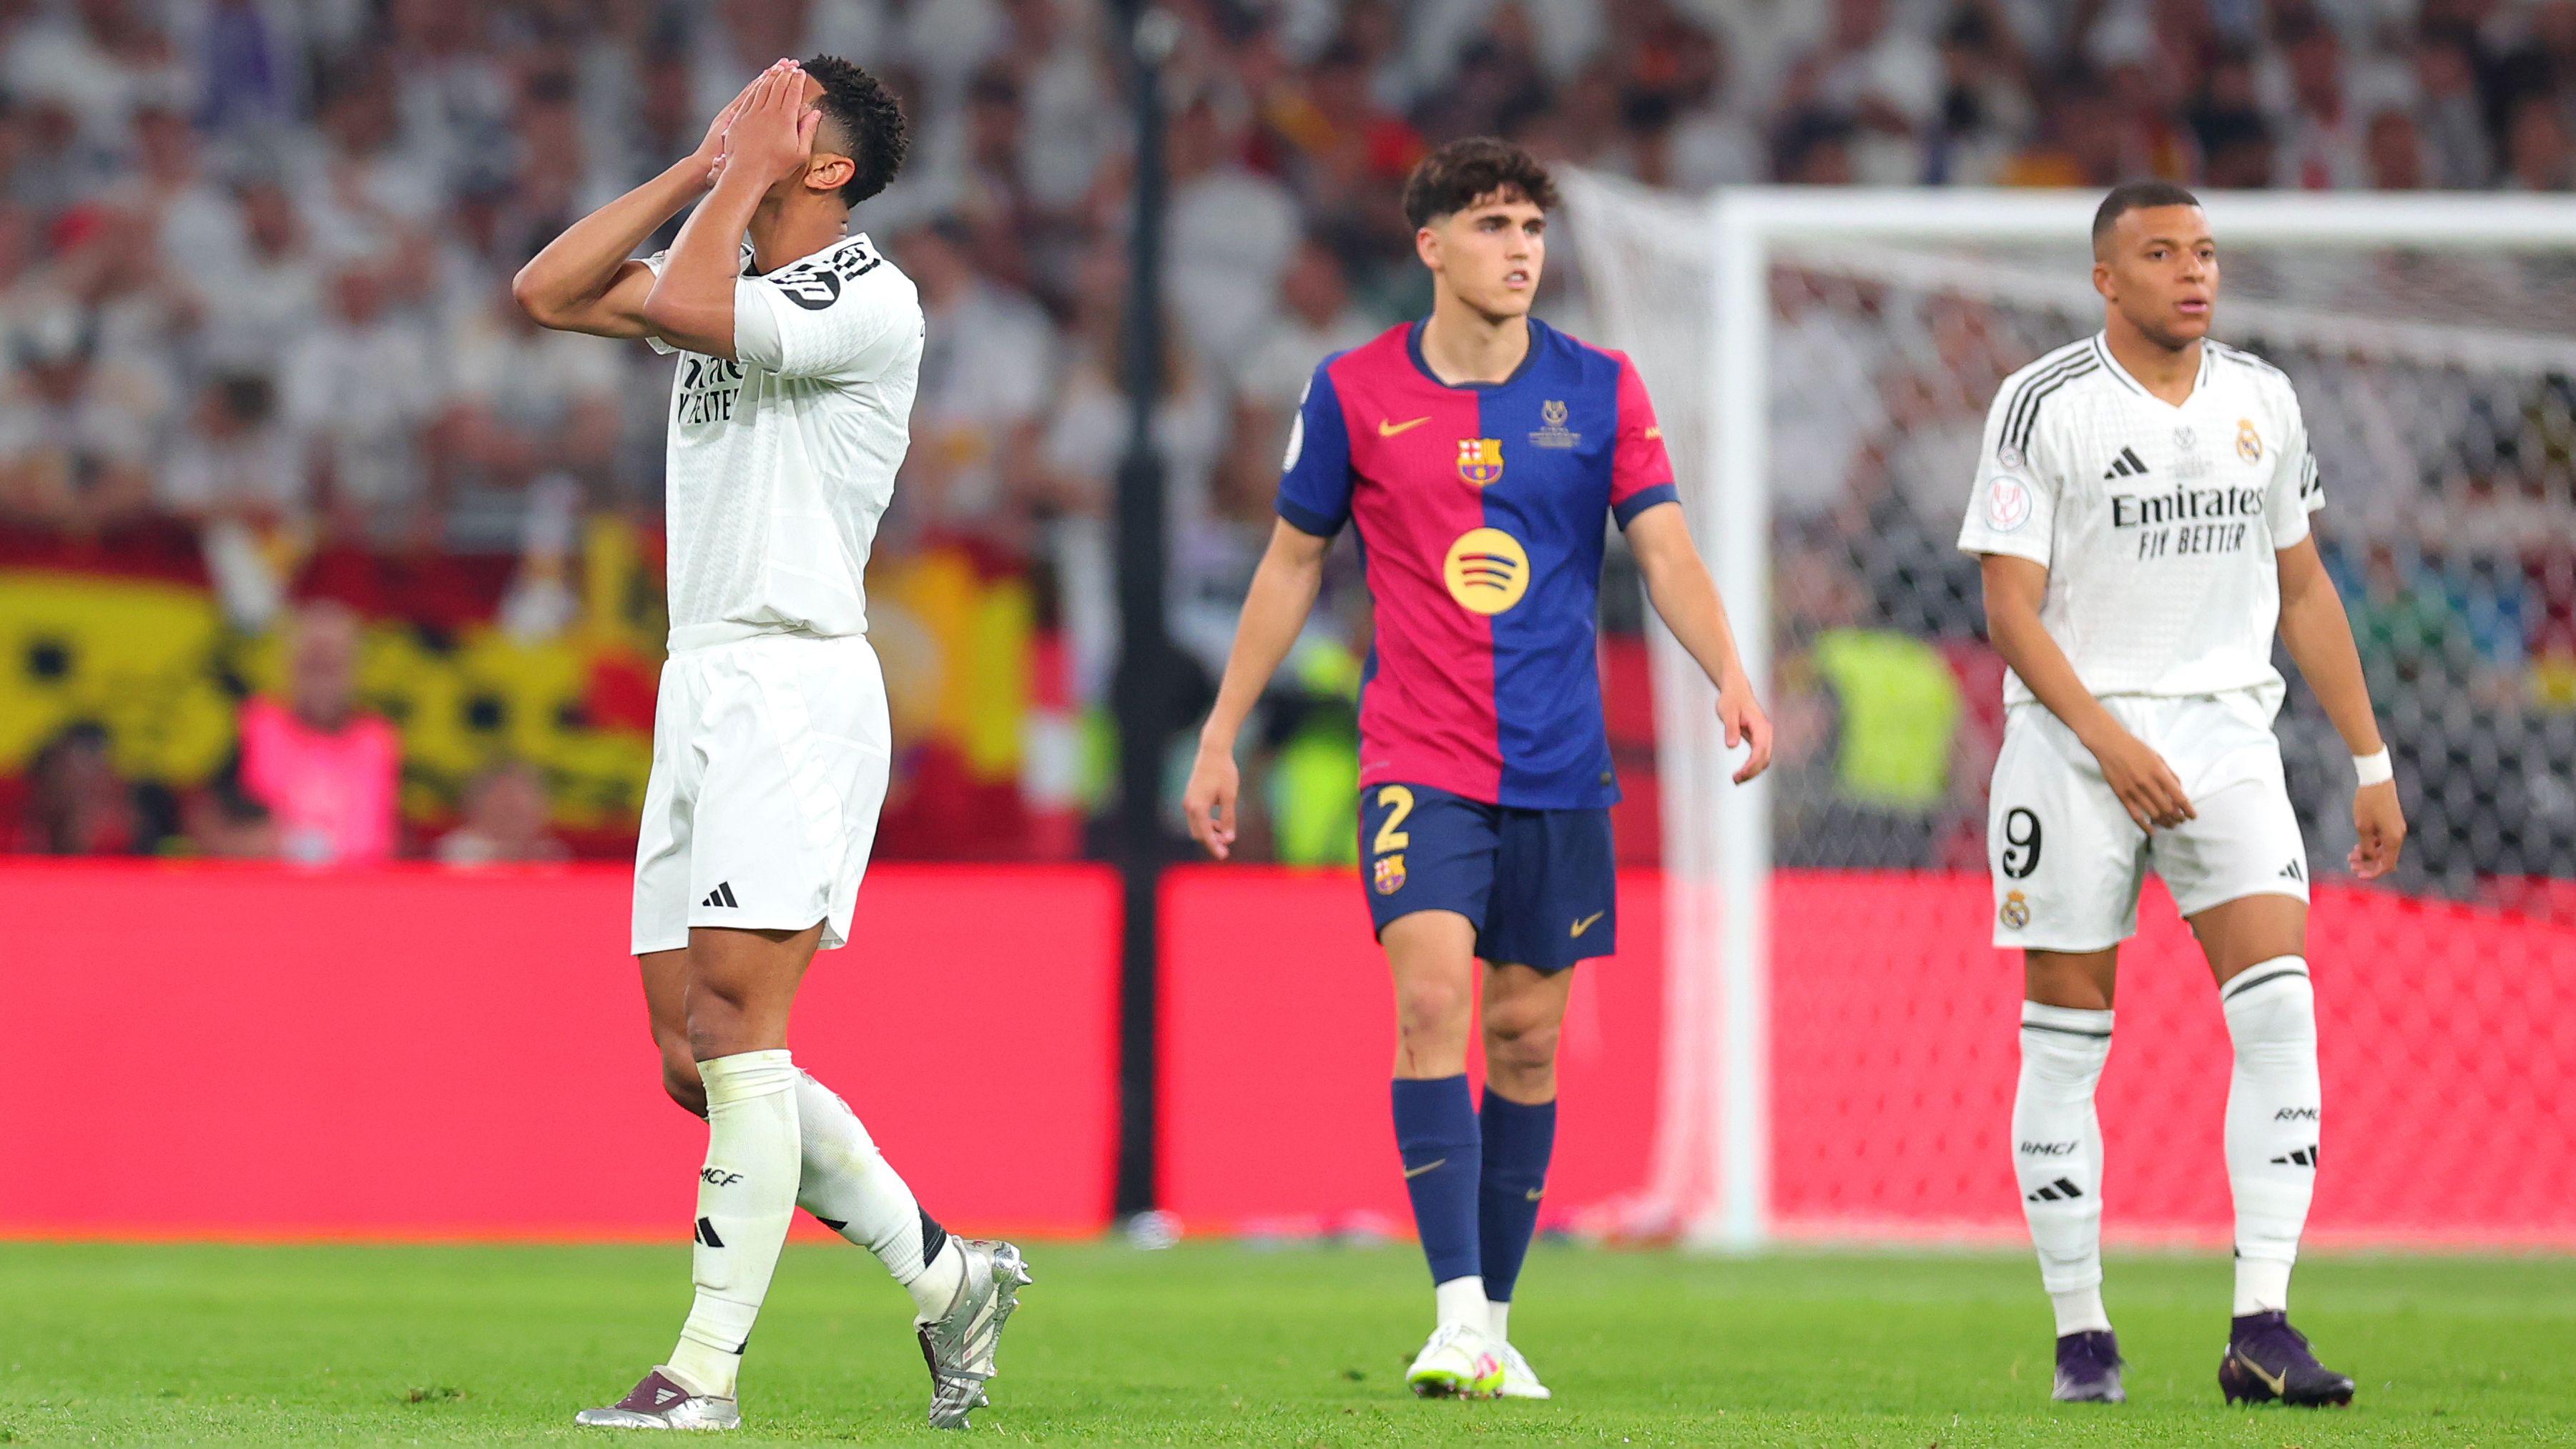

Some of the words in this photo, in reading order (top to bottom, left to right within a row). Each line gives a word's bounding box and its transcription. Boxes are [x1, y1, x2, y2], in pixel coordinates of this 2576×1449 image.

[2110, 483, 2263, 528] Emirates
[2177, 522, 2246, 554] BETTER
[1372, 785, 1415, 855] 2
[2002, 806, 2042, 879] 9
[2274, 1106, 2321, 1121] RMC
[700, 1167, 744, 1187] MCF
